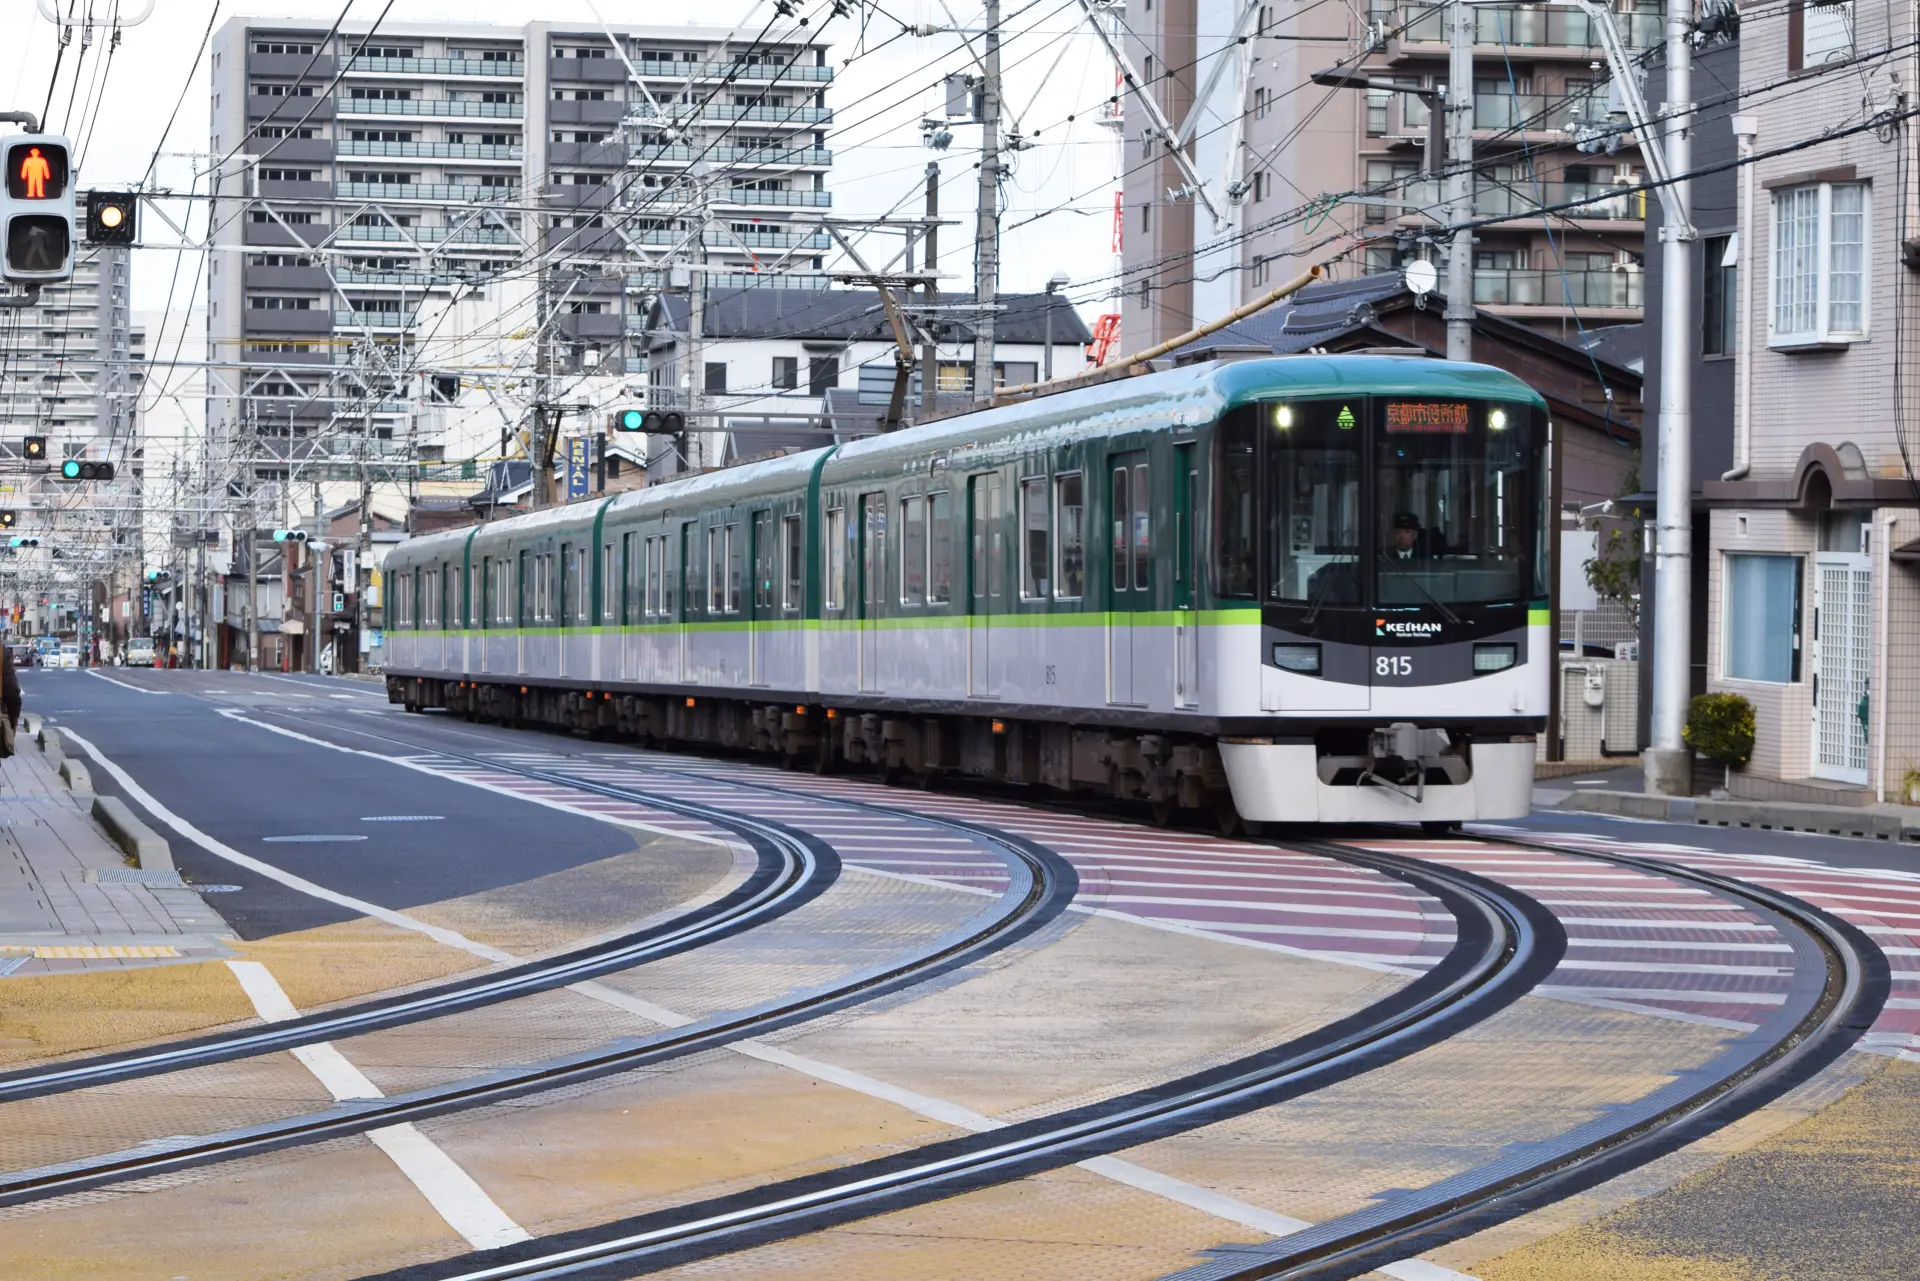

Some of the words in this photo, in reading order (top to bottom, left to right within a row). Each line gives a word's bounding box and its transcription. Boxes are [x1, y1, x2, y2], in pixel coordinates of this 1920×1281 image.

[1387, 403, 1469, 424] 京都市役所前
[572, 441, 585, 486] RENTAL
[1386, 621, 1442, 632] KEIHAN
[1376, 655, 1412, 676] 815
